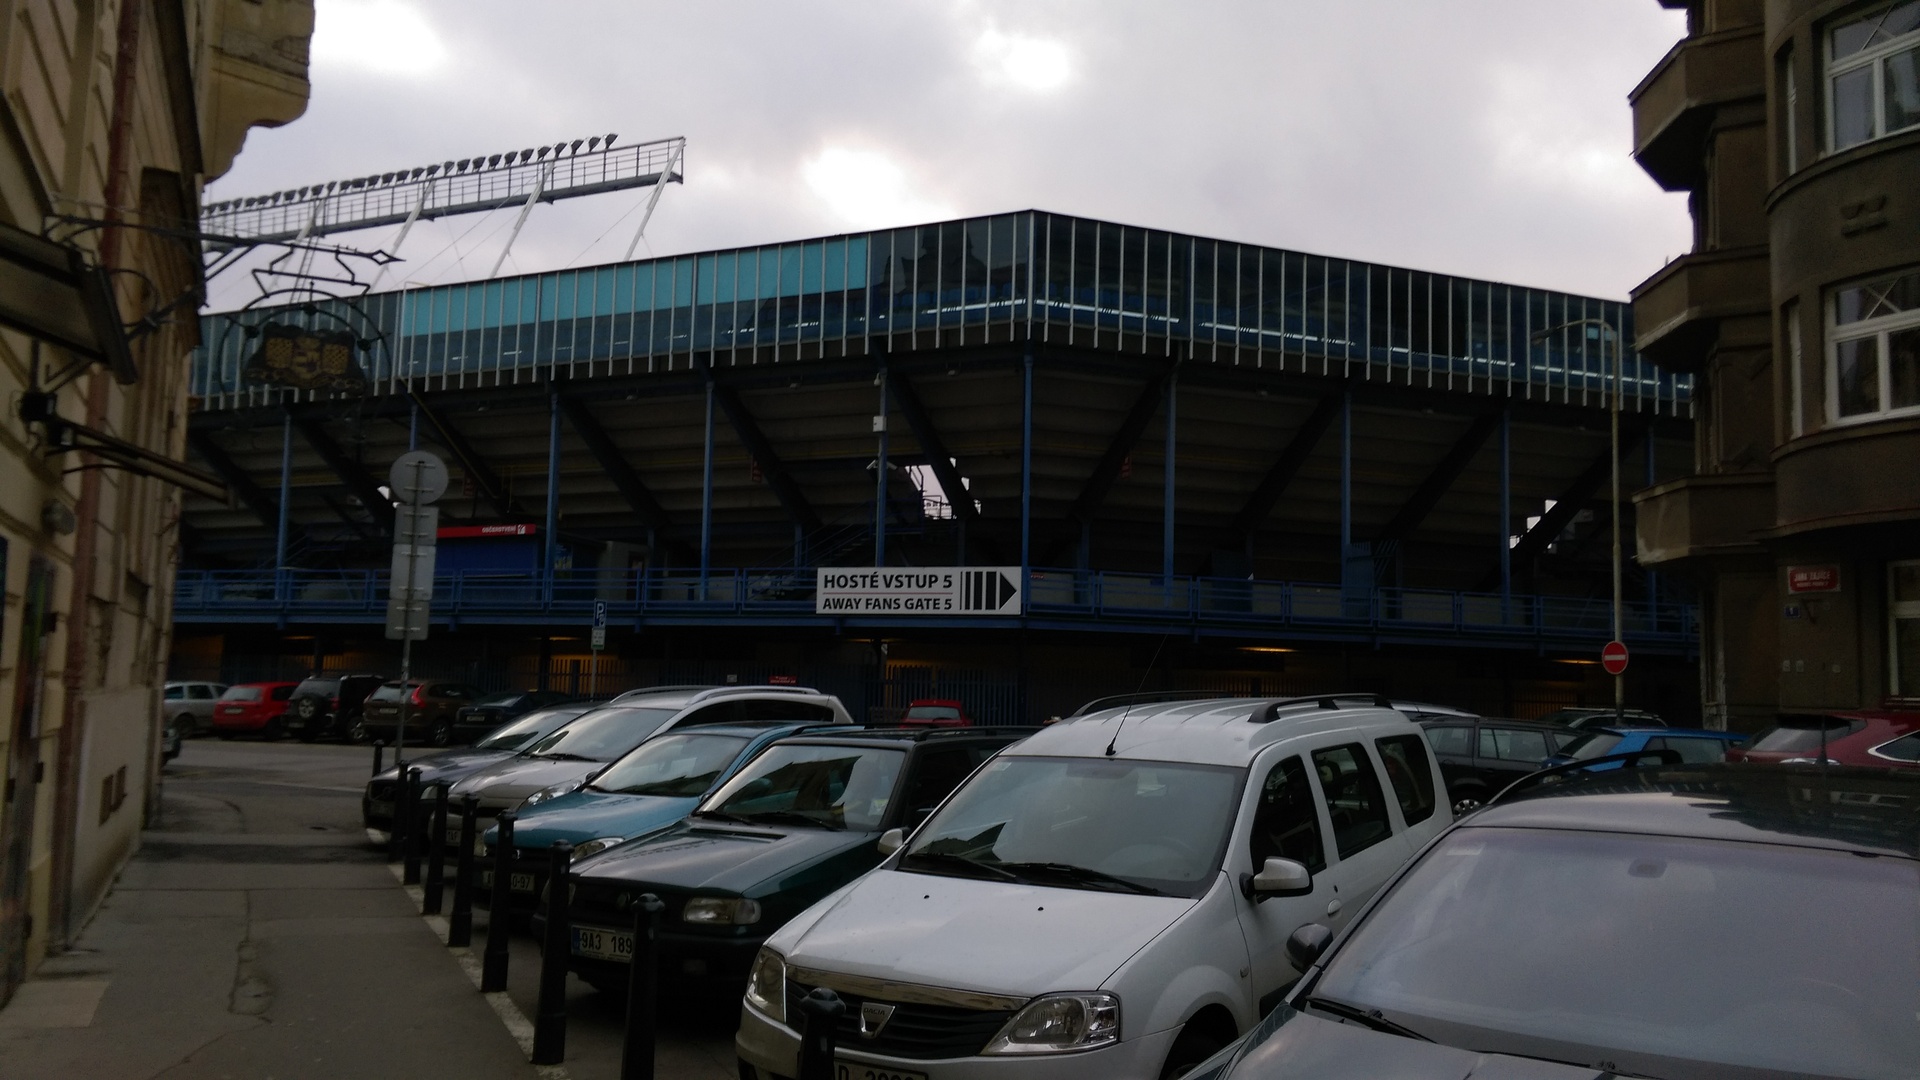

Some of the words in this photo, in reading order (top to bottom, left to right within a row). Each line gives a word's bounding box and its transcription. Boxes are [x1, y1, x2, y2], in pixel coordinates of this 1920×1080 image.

[824, 572, 879, 588] HOSTÉ
[883, 574, 939, 588] VSTUP
[943, 575, 953, 588] 5
[823, 598, 862, 610] AWAY
[865, 598, 901, 610] FANS
[904, 598, 940, 610] GATE
[944, 598, 952, 610] 5
[582, 932, 602, 950] 9A3
[611, 936, 633, 954] 189
[864, 1007, 886, 1016] DACIA
